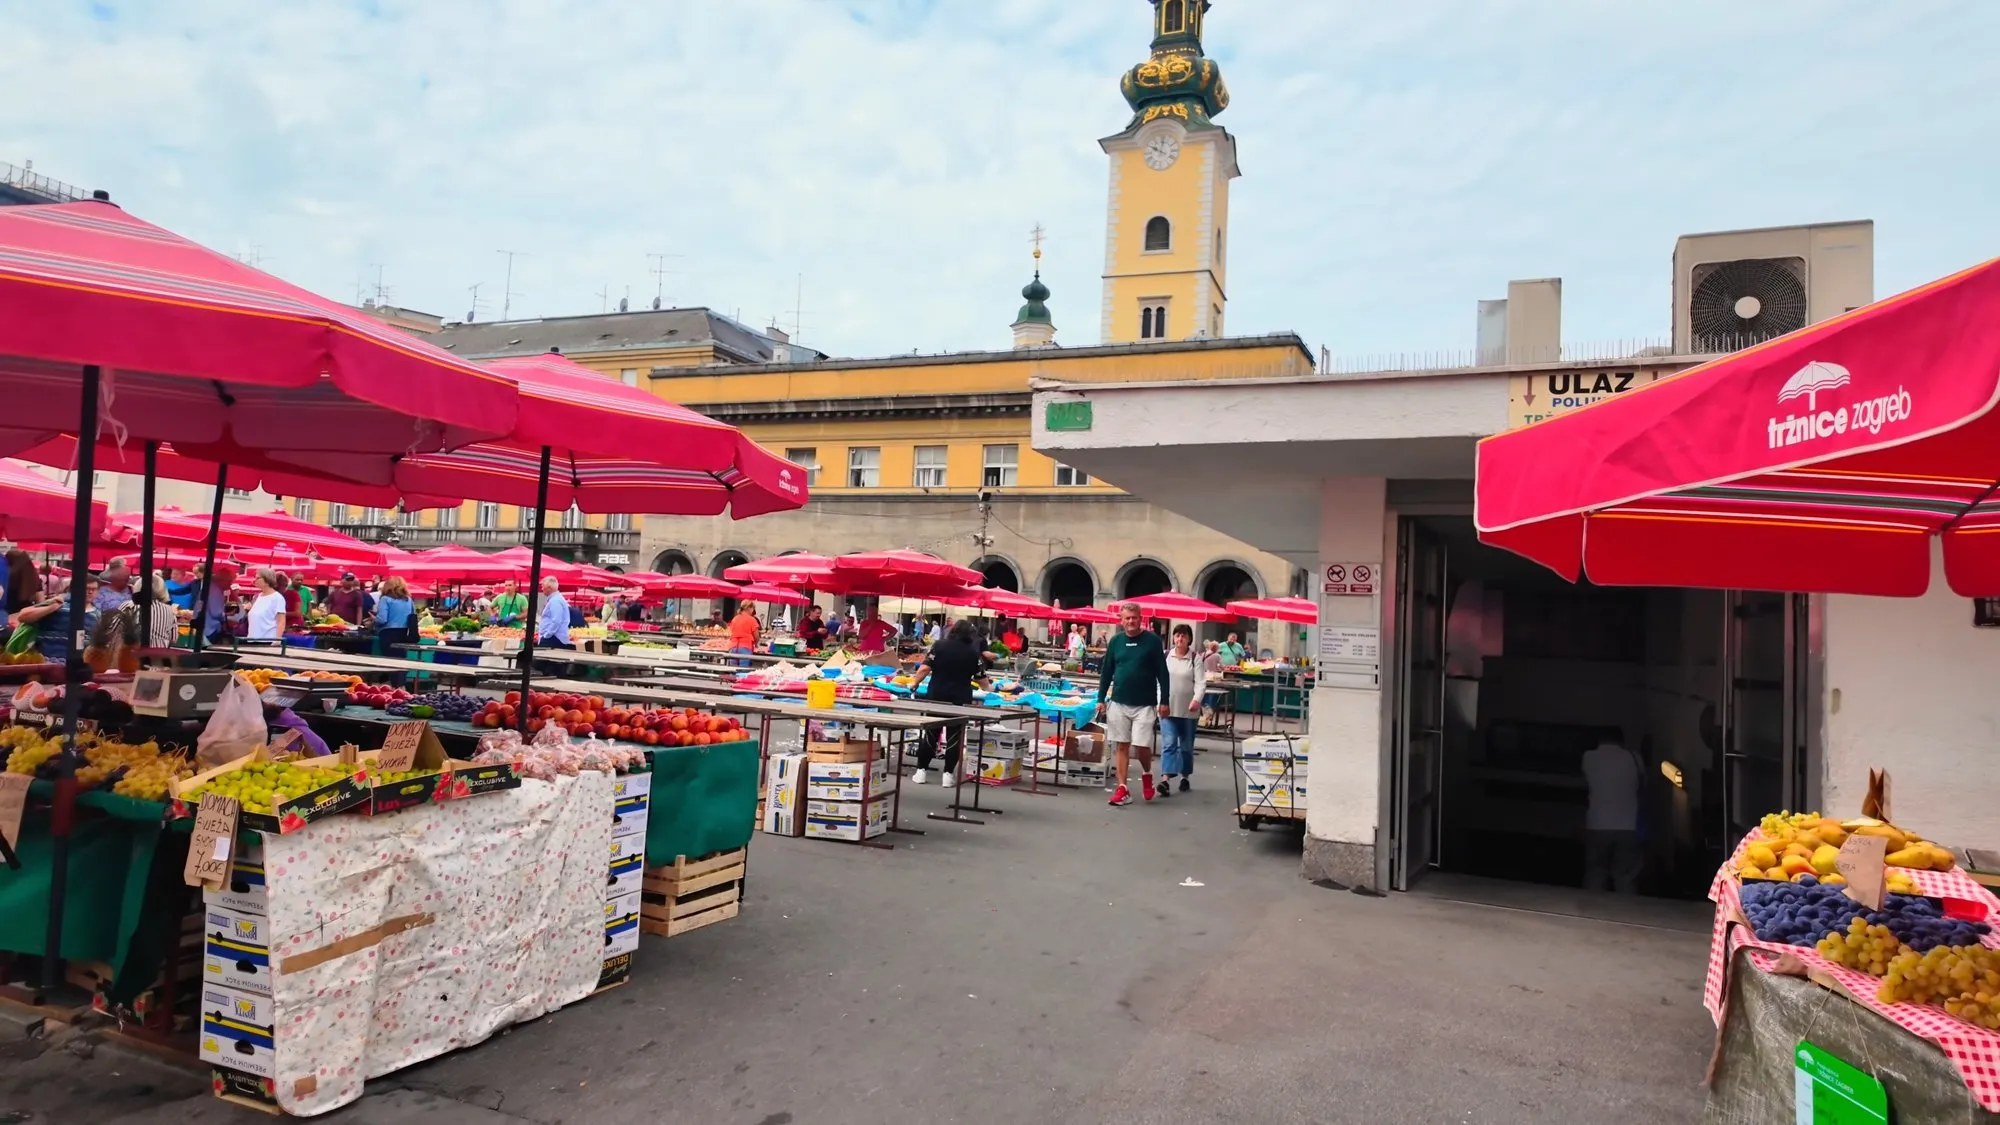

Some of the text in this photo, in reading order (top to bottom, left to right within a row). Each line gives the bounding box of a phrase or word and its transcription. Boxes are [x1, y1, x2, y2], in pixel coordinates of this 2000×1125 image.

[1549, 372, 1634, 394] ULAZ
[1768, 385, 1911, 449] tržnice zagreb
[304, 791, 351, 816] EXCLUSIVE
[773, 783, 785, 809] BONITA
[602, 954, 629, 969] DELUXE
[225, 976, 271, 991] PREMIUM PACK
[221, 1056, 267, 1073] PREMIUM PACK
